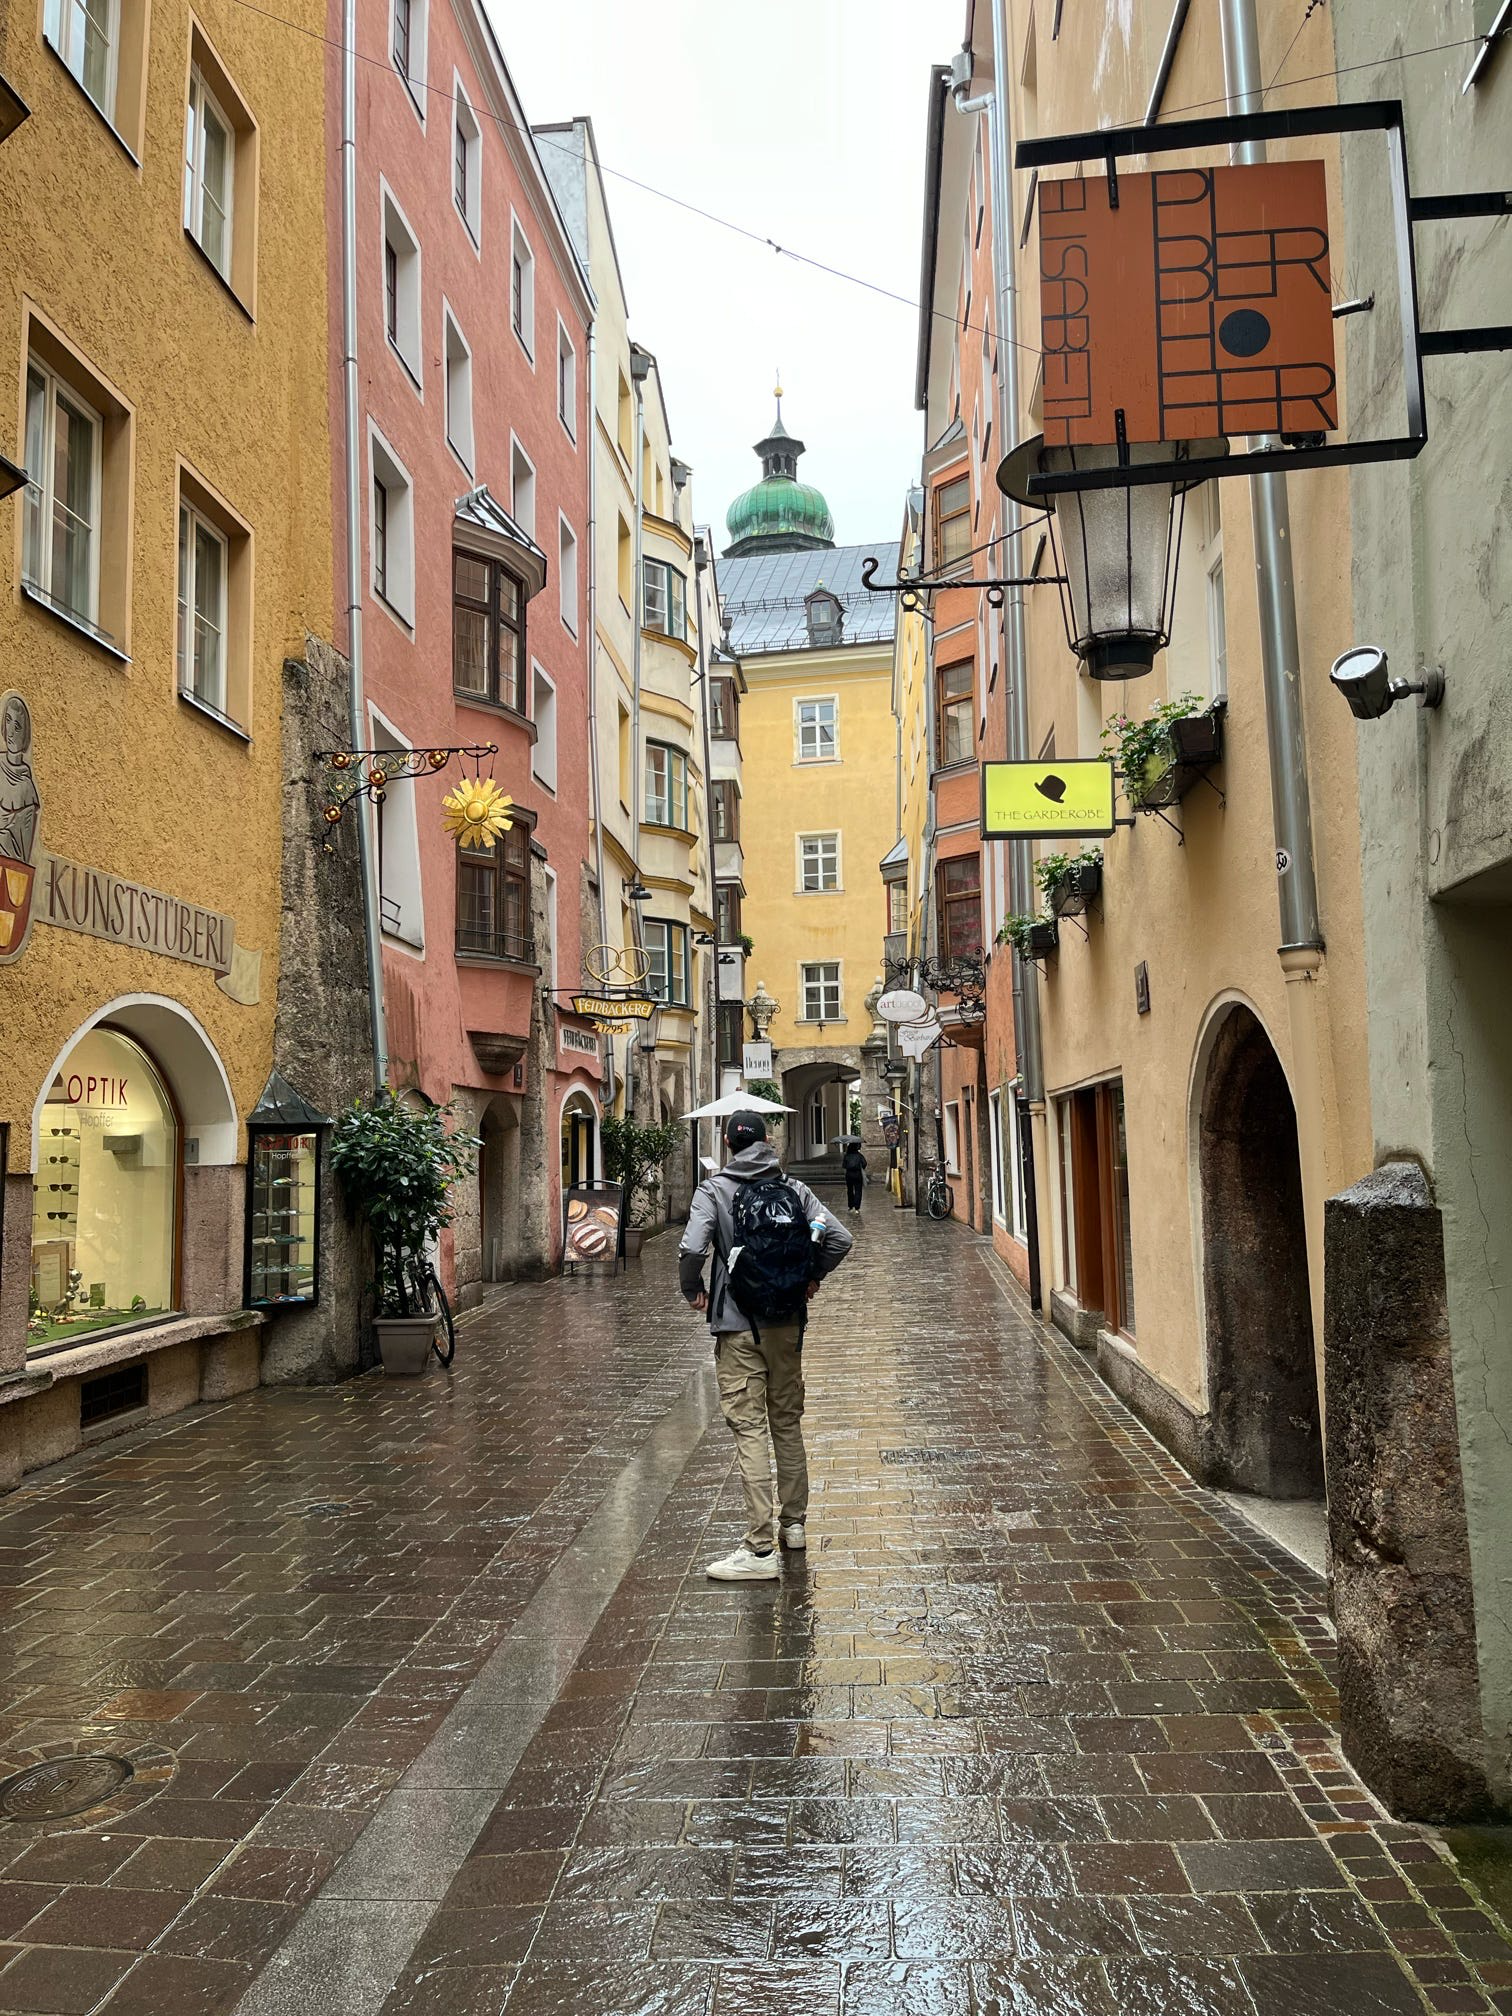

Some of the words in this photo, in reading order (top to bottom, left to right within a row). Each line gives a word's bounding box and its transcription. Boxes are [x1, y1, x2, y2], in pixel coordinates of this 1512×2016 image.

[994, 810, 1022, 820] THE
[1024, 809, 1105, 820] GARDEROBE
[46, 859, 227, 966] KUNSTSTÜBERL
[578, 998, 653, 1019] FEINBÄCKEREI
[601, 1025, 623, 1033] 1795
[67, 1074, 128, 1105] OPTIK
